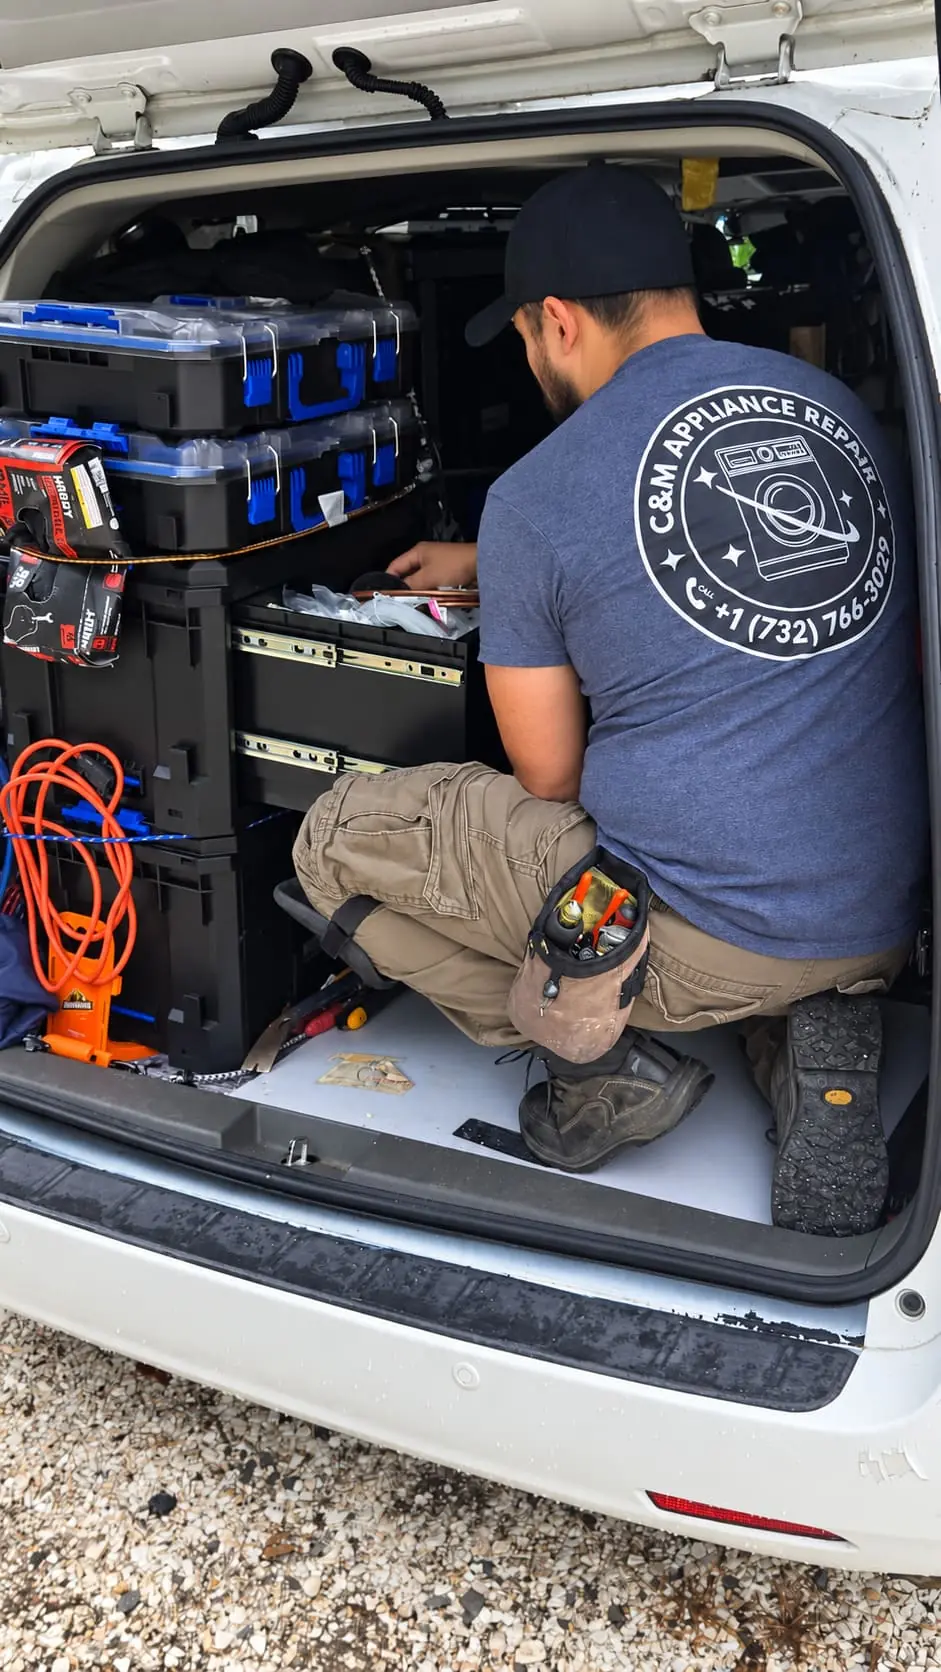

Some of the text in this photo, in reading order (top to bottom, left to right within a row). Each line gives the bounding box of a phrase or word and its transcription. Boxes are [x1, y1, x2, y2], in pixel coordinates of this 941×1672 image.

[648, 395, 877, 534] C&M APPLIANCE REPAIR
[698, 585, 714, 599] CALL
[714, 536, 890, 647] +1 (732) 766-3029
